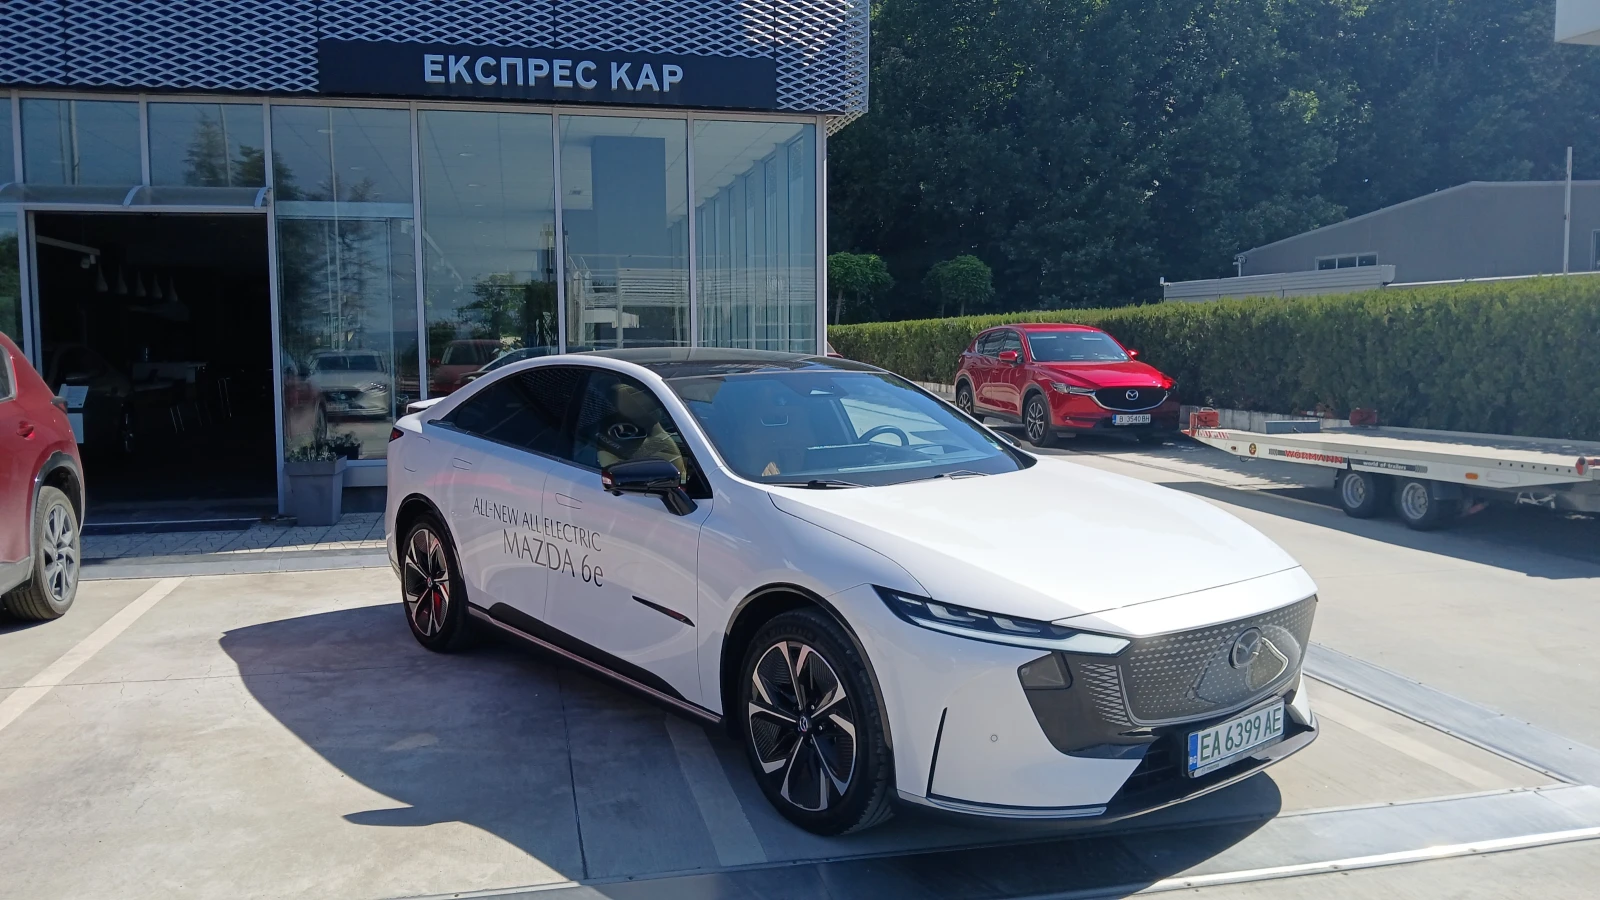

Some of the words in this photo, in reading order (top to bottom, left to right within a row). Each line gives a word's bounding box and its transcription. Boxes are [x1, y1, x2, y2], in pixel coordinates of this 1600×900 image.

[423, 53, 598, 90] ЕКСПРЕС
[610, 61, 684, 92] КАР
[472, 497, 520, 526] ALL-NEW
[522, 511, 542, 534] ALL
[544, 517, 602, 552] ELECTRIC
[502, 528, 576, 578] MAZDA
[581, 554, 604, 587] 6e
[1200, 730, 1221, 762] EA
[1224, 715, 1262, 752] 6399
[1263, 707, 1282, 737] AE
